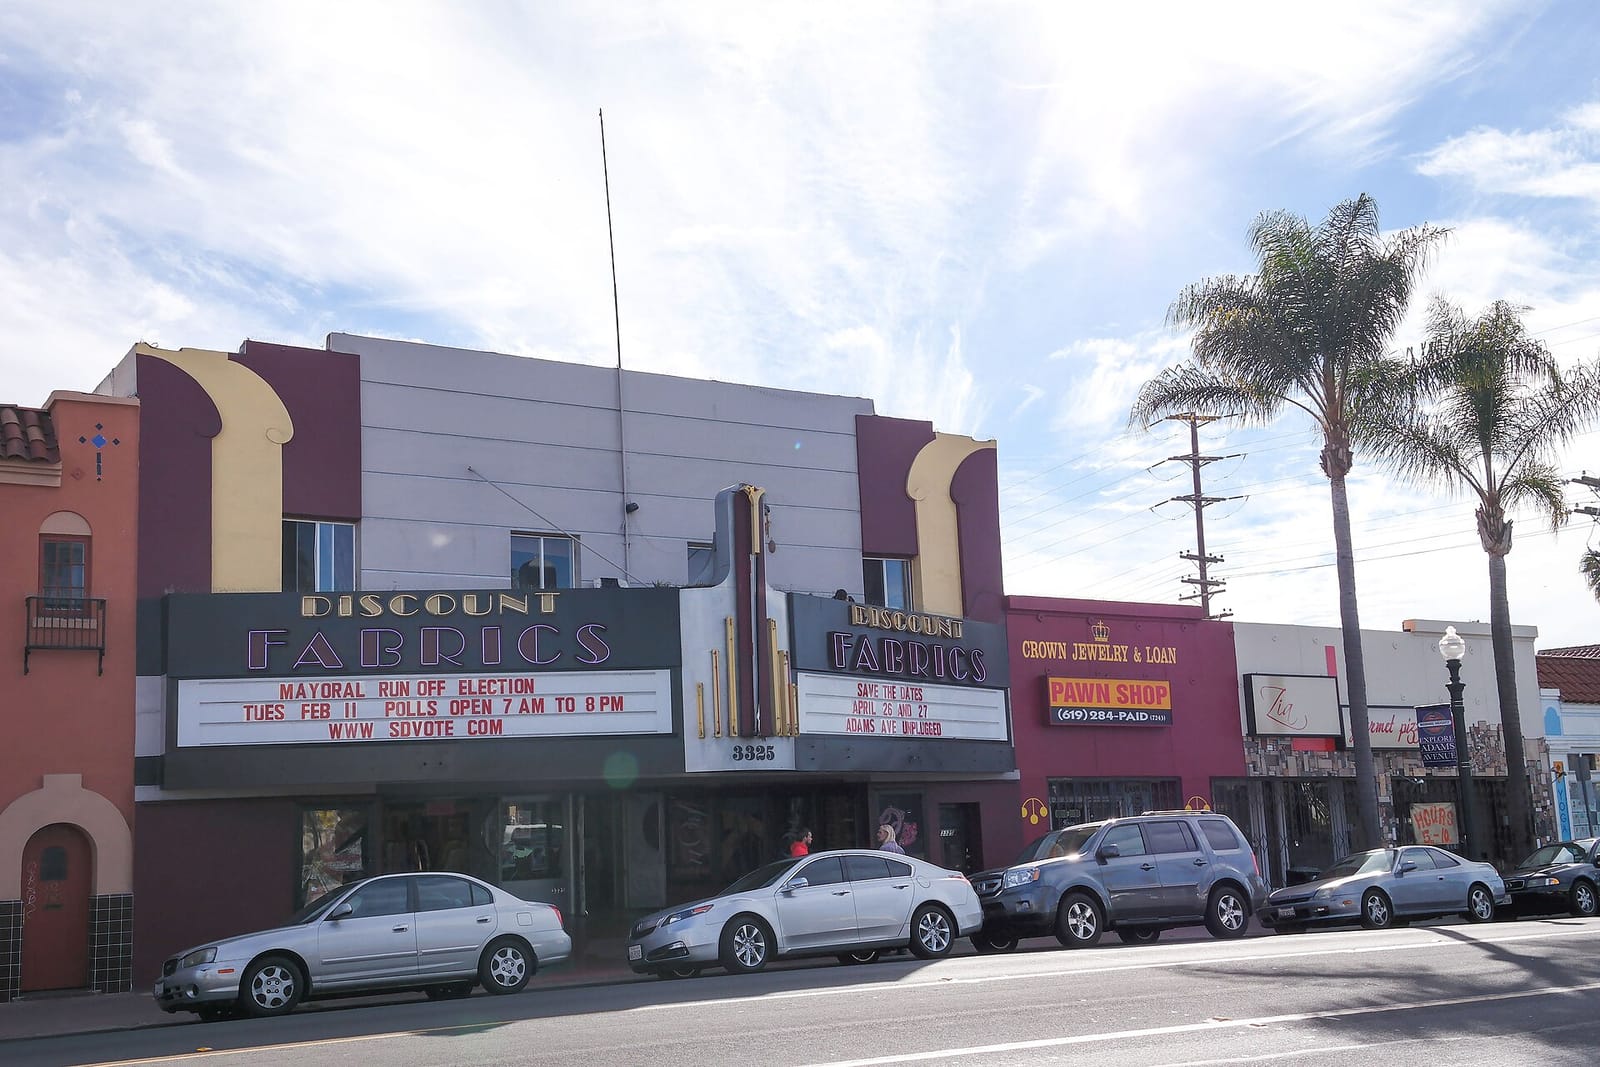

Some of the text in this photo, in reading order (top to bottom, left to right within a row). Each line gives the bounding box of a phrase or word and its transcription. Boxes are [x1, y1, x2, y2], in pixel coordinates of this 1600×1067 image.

[301, 592, 560, 617] DISCOUNT
[851, 604, 963, 638] DISCOUNT
[248, 623, 611, 670] FABRICS
[830, 631, 987, 682] FABRICS
[1022, 640, 1177, 664] CROWN JEWELRY & LOAN
[279, 678, 535, 700] MAYORAL RUN OFF ELECTION
[857, 682, 923, 701] SAVE THE DATES
[1051, 681, 1168, 705] PAWN SHOP
[243, 704, 285, 721] TUES
[301, 703, 331, 720] FEB
[385, 700, 438, 717] POLLS
[450, 699, 492, 716] OPEN
[503, 698, 513, 714] 7
[518, 697, 545, 714] AM
[555, 696, 576, 713] TO
[585, 696, 595, 712] 8
[600, 695, 624, 711] PM
[853, 701, 928, 718] APRIL 26 AND 27
[1057, 708, 1088, 721] (619)
[1090, 709, 1149, 721] 284-PAID
[328, 719, 503, 739] WWW SDVOTE COM
[846, 718, 942, 736] ADAMS AVE UNPLUGGED
[732, 745, 775, 761] 3325
[1422, 742, 1456, 752] ADAMS
[1423, 752, 1457, 761] AVENUE
[1413, 804, 1455, 830] HOURS
[1557, 789, 1568, 834] YOGA
